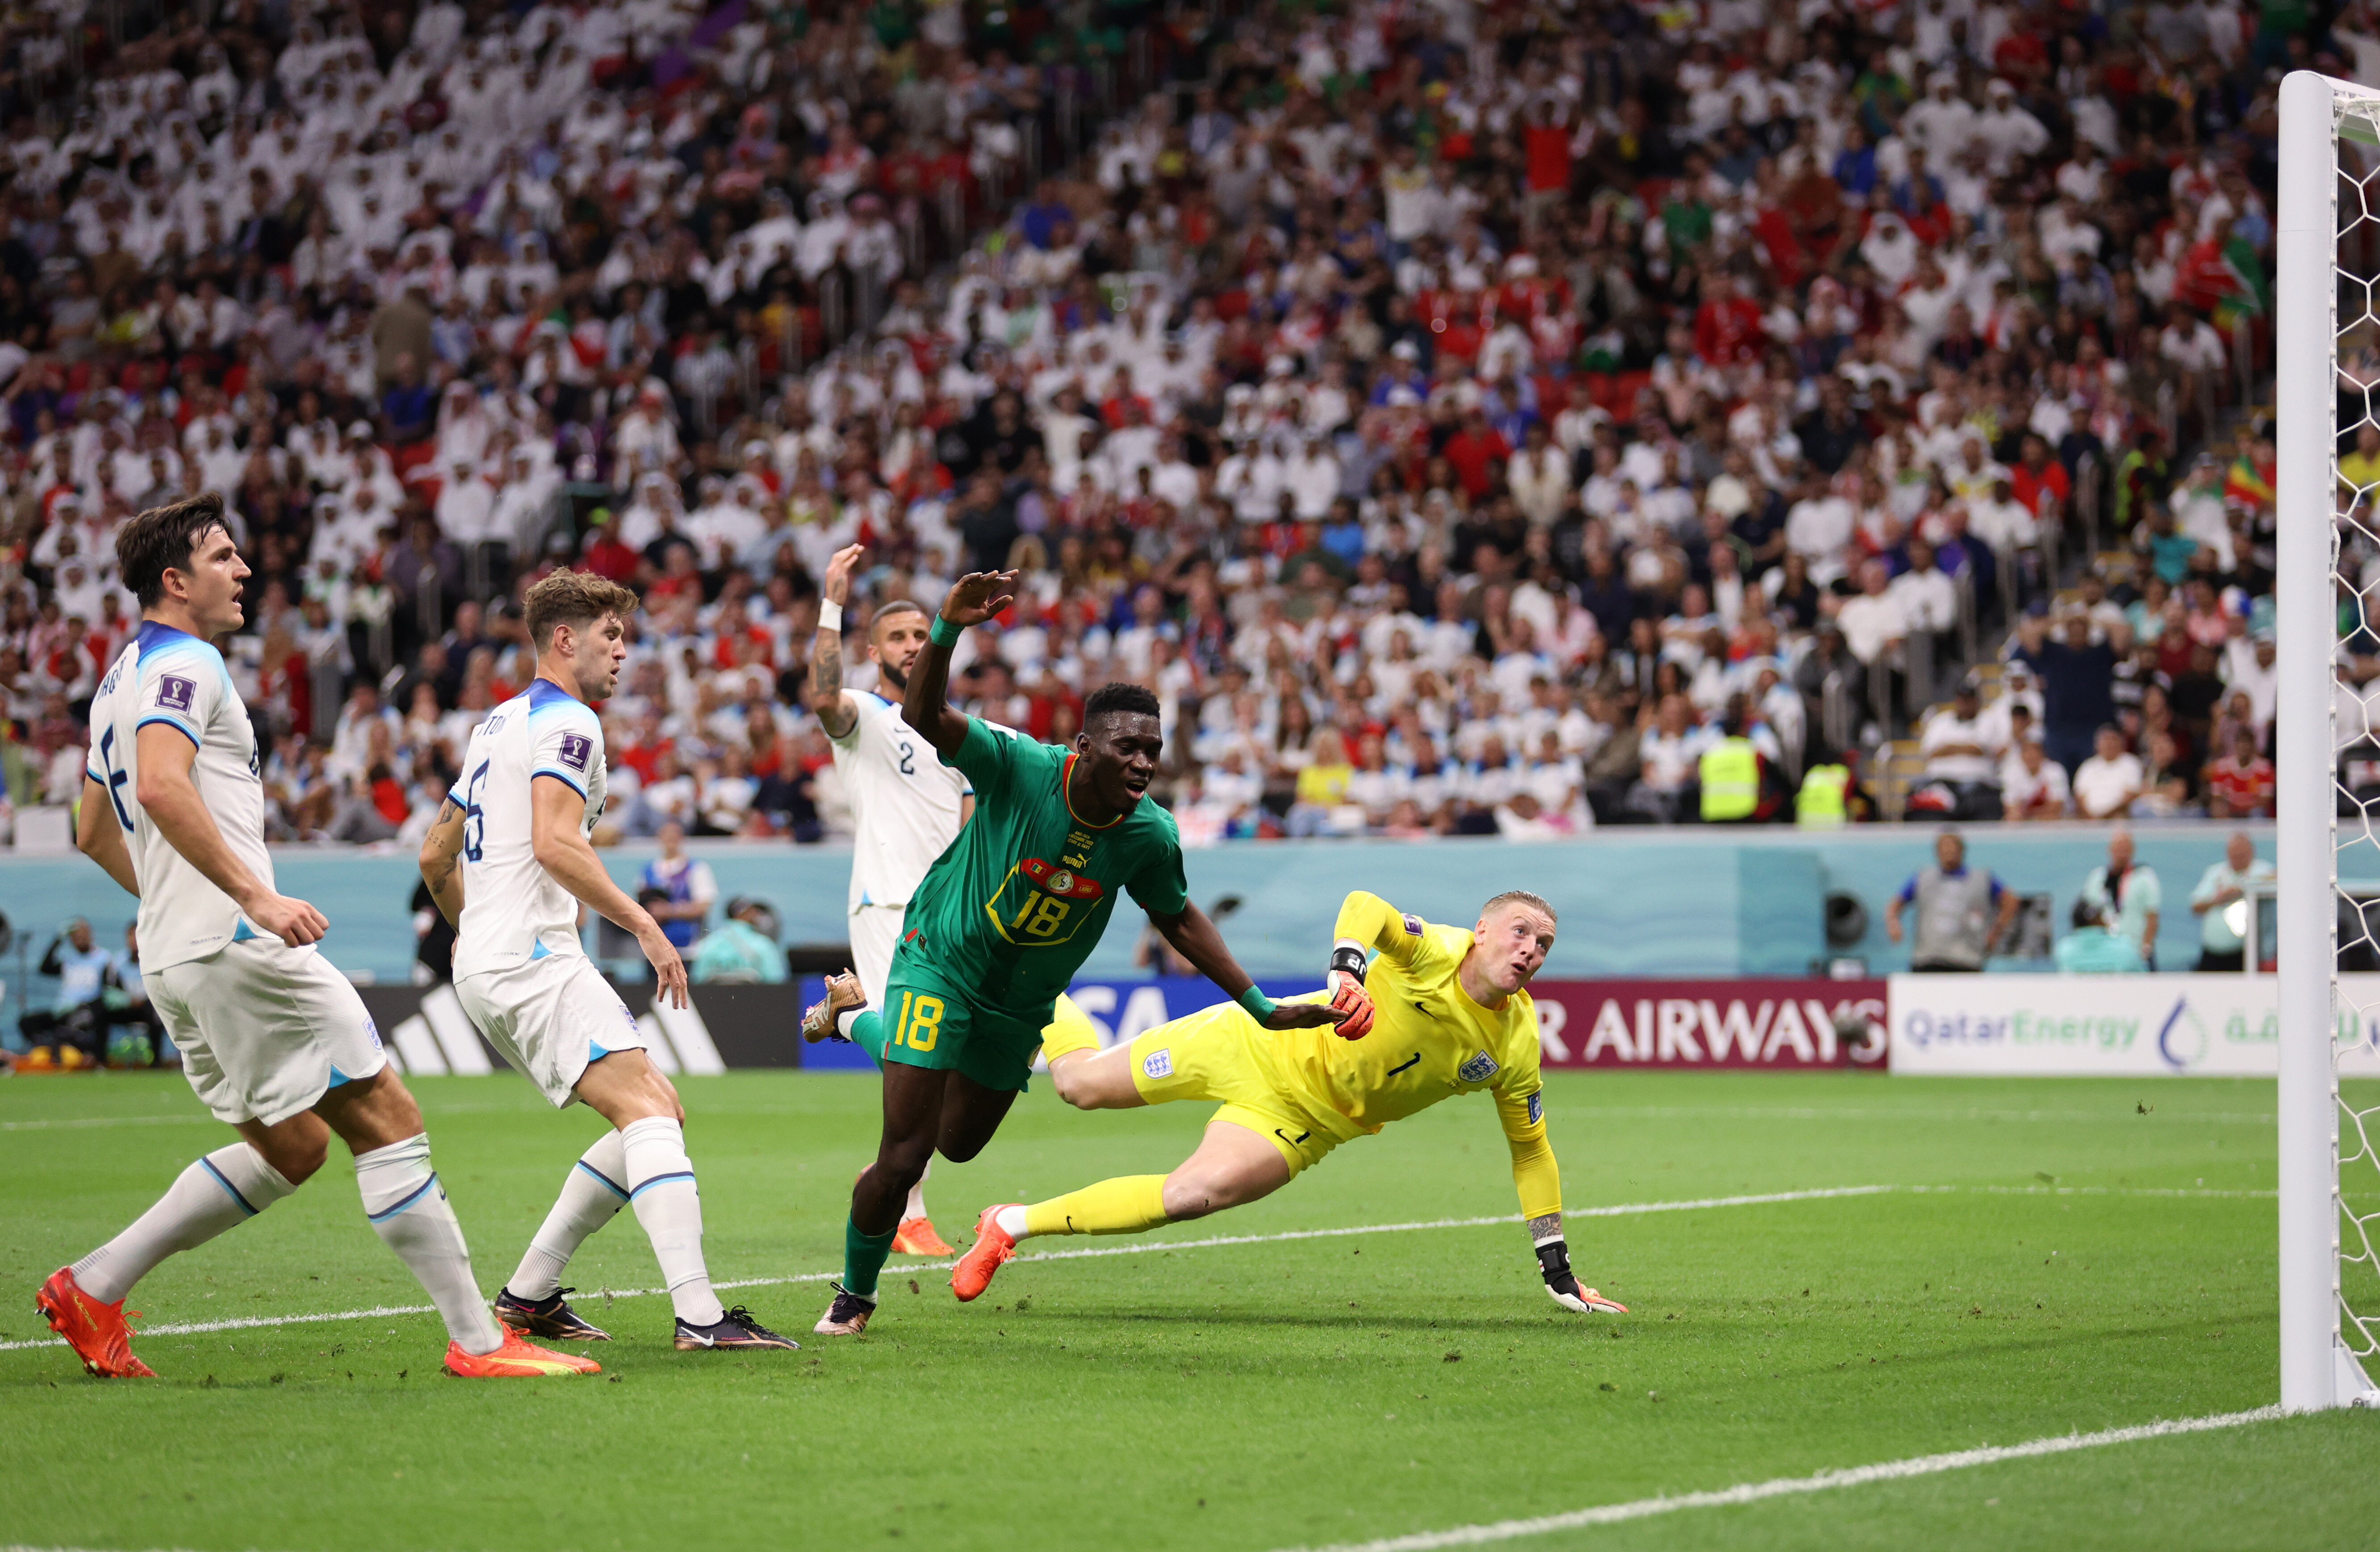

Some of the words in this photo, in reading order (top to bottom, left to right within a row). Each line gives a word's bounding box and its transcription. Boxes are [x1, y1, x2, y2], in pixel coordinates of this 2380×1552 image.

[900, 741, 915, 775] 2
[1062, 855, 1083, 868] PUMA
[1011, 889, 1070, 937] 18
[894, 990, 945, 1052] 18
[1583, 998, 1886, 1063] AIRWAYS
[1904, 1009, 2140, 1047] QatarEnergy
[1387, 1052, 1421, 1078] 1
[73, 1295, 98, 1331] ULTRA
